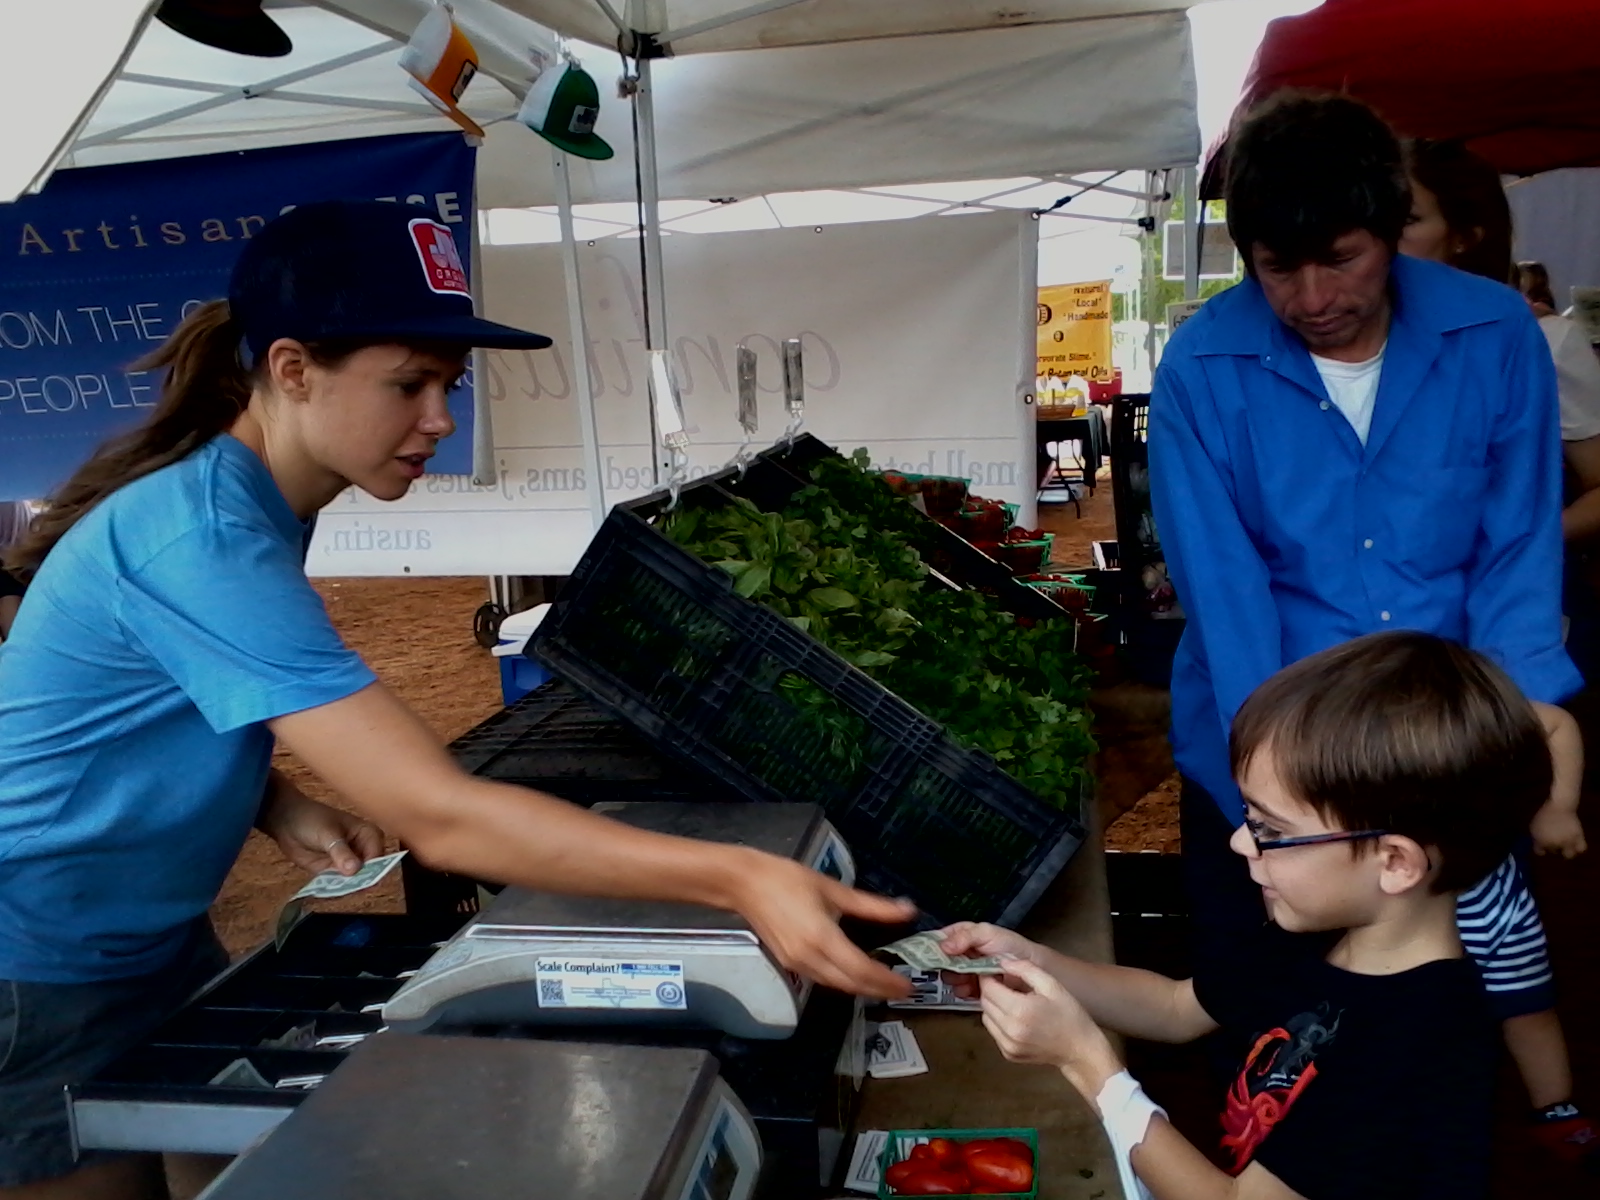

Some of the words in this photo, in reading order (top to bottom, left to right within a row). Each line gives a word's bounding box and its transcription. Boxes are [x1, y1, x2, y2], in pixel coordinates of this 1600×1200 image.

[18, 214, 265, 256] Artisan
[0, 308, 72, 350] OM
[77, 303, 169, 343] THE
[537, 961, 562, 972] Scale
[564, 961, 620, 975] Complaint?
